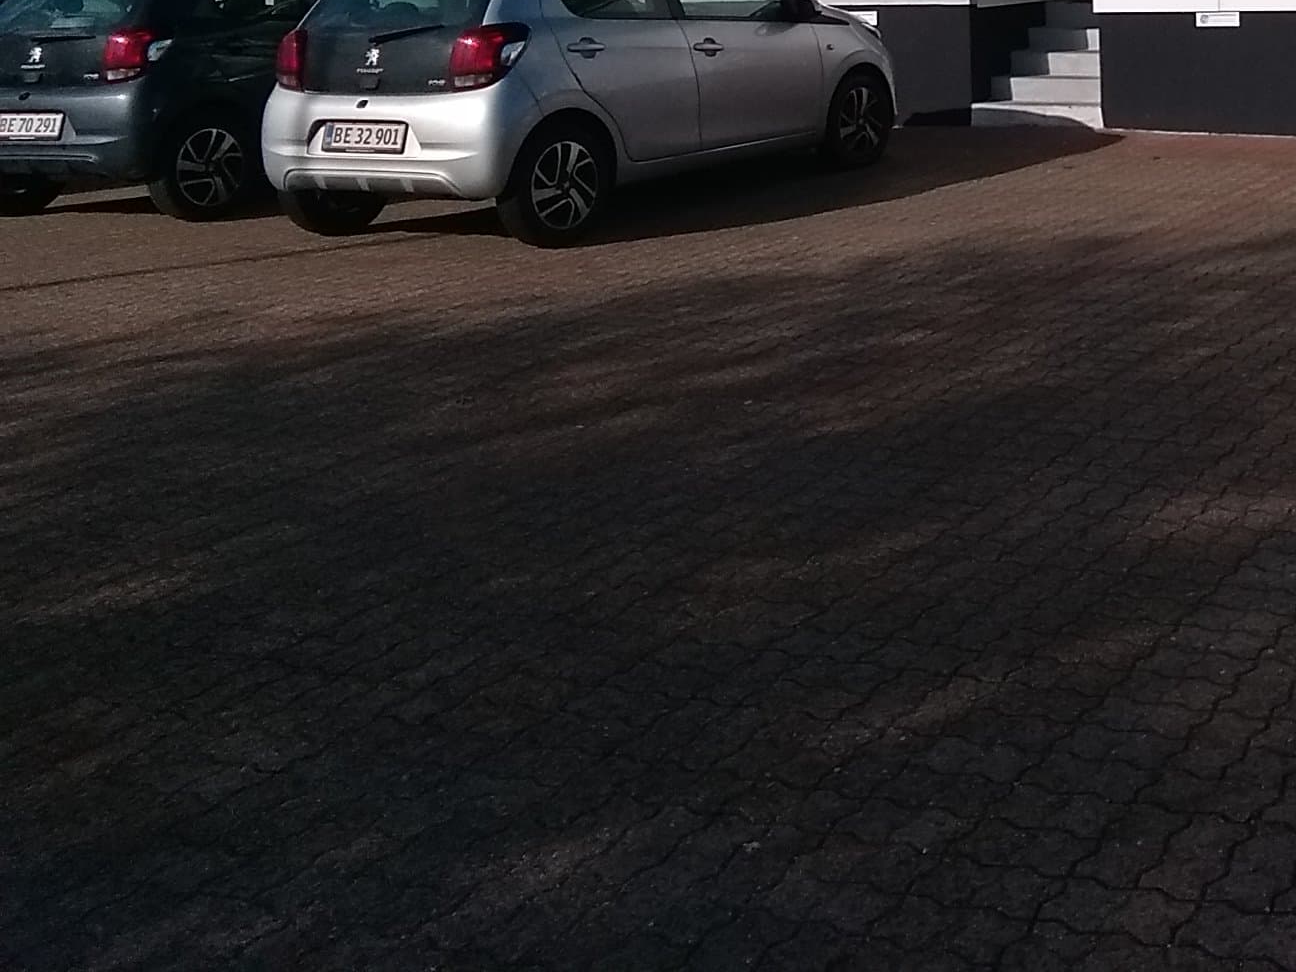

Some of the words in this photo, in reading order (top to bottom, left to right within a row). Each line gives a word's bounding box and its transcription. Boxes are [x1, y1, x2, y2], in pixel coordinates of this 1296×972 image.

[18, 117, 34, 133] 70
[35, 117, 57, 133] 291
[333, 127, 353, 144] BE
[354, 128, 373, 145] 32
[375, 128, 399, 146] 901
